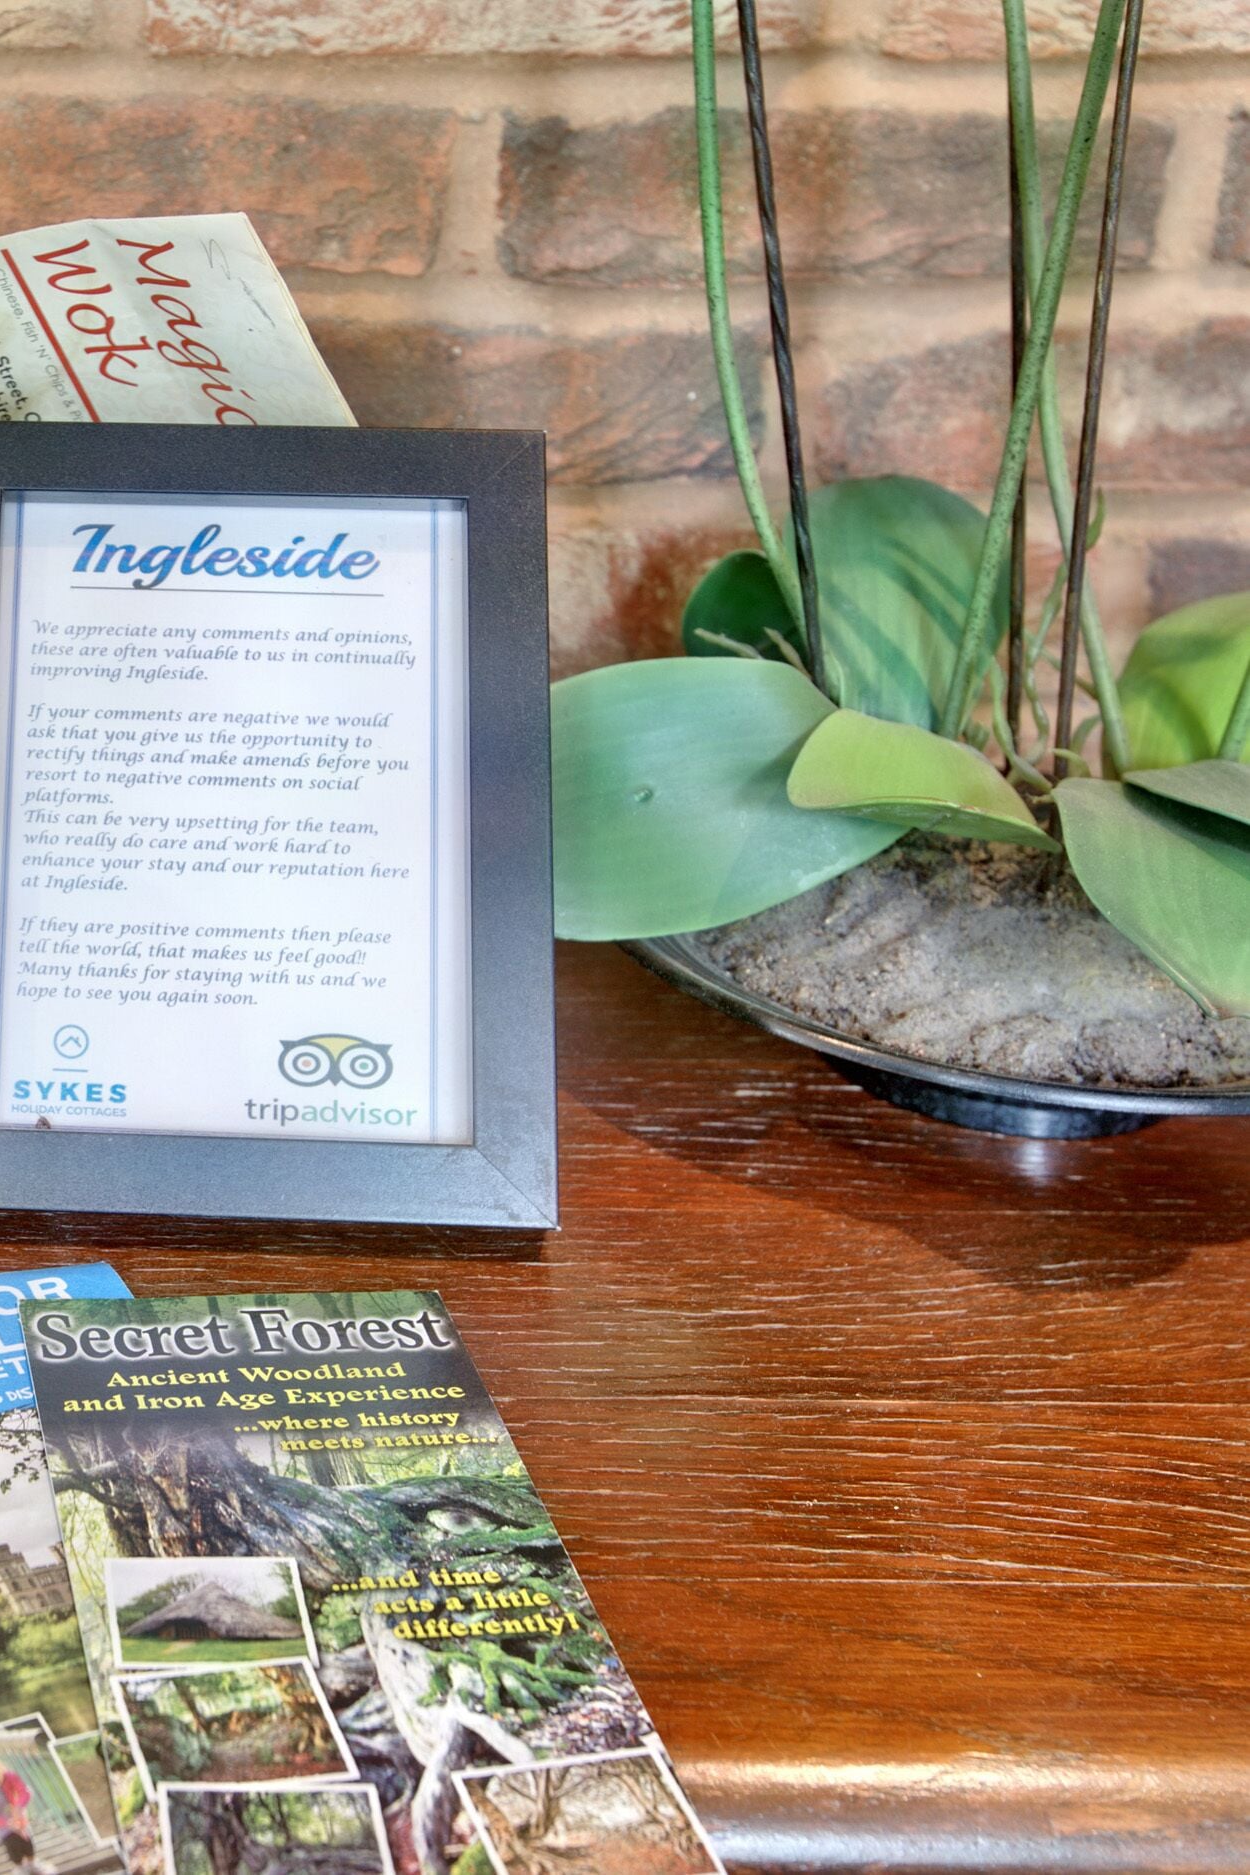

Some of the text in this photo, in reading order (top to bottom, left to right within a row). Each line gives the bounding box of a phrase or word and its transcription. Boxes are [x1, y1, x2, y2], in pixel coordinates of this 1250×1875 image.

[32, 238, 154, 387] Wok
[115, 238, 258, 425] Magic
[71, 523, 381, 590] Ingleside
[31, 619, 414, 647] We appreciate any comments and opinions,
[30, 641, 417, 670] these are often valuable to us in continually
[29, 664, 209, 684] improving Ingleside.
[27, 703, 394, 728] If your comments are negative we would
[26, 725, 372, 752] ask that you give us the opportunity to
[12, 1080, 127, 1103] SYKES
[11, 1103, 127, 1118] HOLIDAY COTTAGES
[244, 1097, 418, 1127] tripadvisor
[35, 1307, 452, 1360] Secret Forest
[106, 1361, 407, 1389] Ancient Woodland
[63, 1383, 466, 1413] and Iron Age Experience
[234, 1409, 461, 1434] ...where history
[279, 1428, 499, 1453] meets nature...
[331, 1567, 502, 1592] ...and time
[373, 1589, 551, 1616] acts a little
[392, 1611, 581, 1641] differently!
